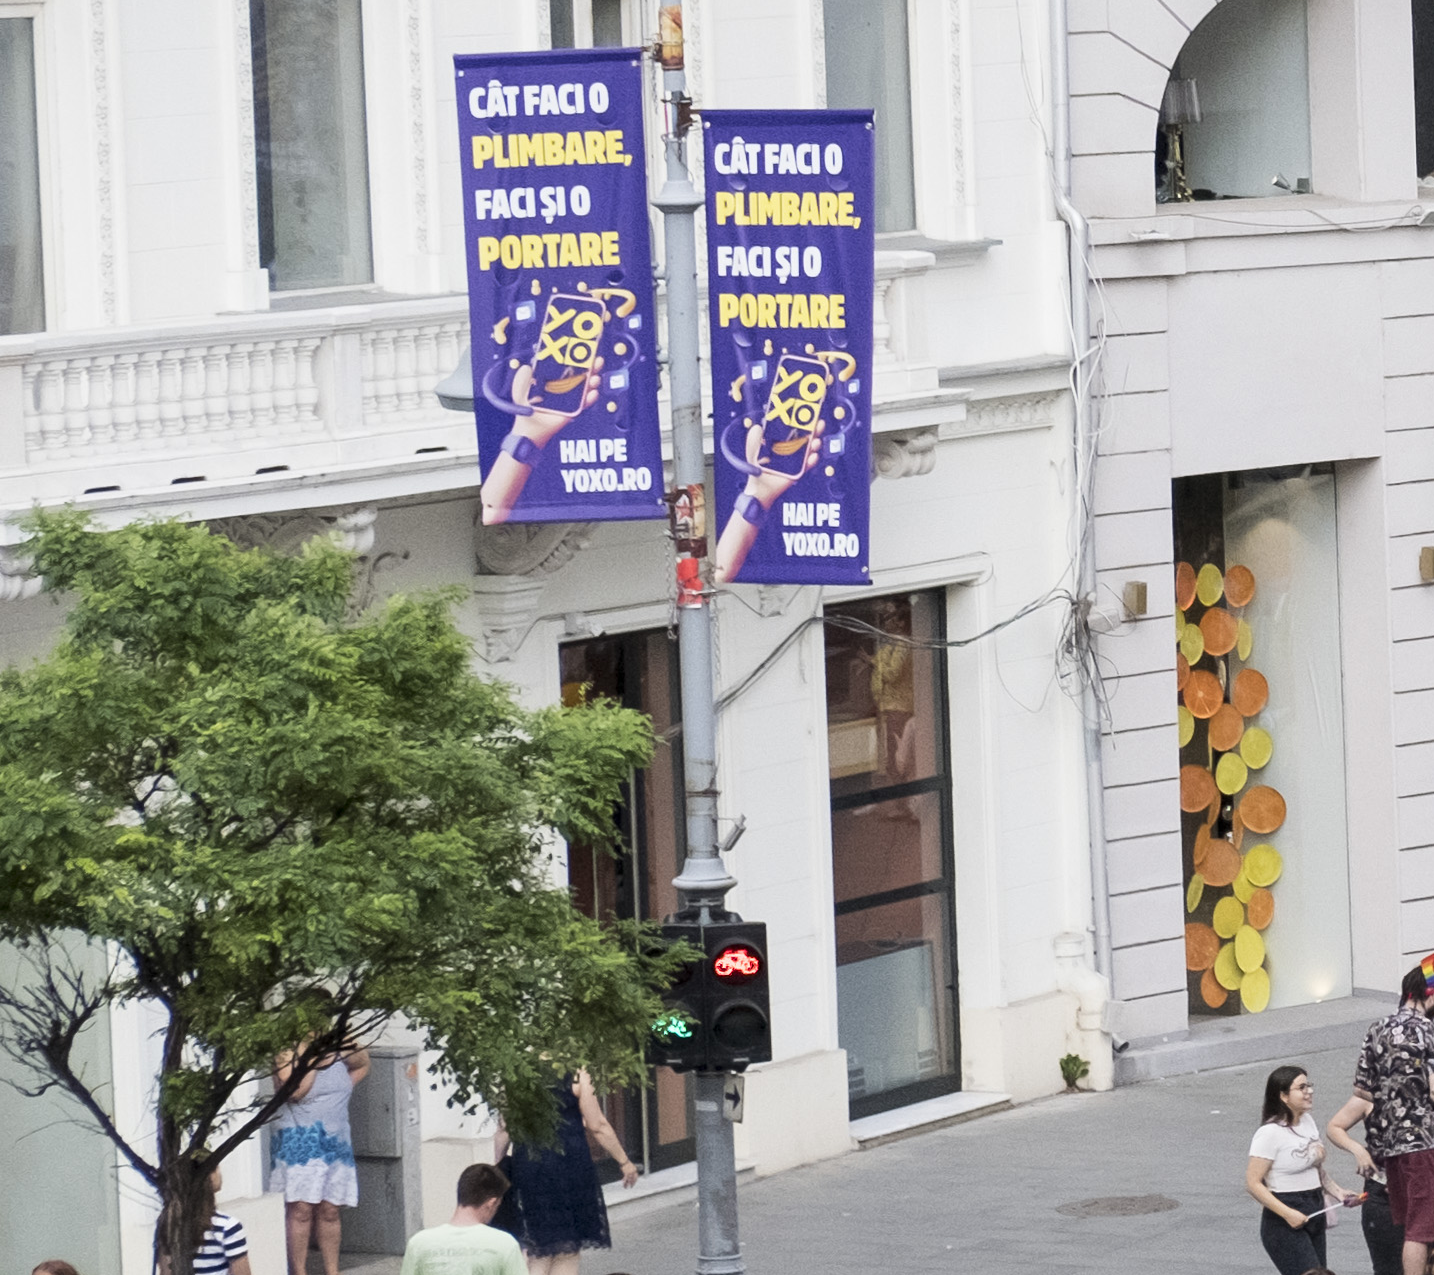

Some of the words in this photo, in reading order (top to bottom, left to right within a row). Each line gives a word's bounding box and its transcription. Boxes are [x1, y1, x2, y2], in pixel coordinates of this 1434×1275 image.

[469, 80, 519, 118] CÂT
[524, 83, 585, 115] FACI
[589, 83, 609, 113] O
[472, 130, 632, 169] PLIMBARE,
[714, 136, 761, 174] CÂT
[765, 143, 820, 174] FACI
[825, 144, 842, 174] O
[475, 188, 536, 220] FACI
[570, 186, 590, 215] O
[716, 192, 861, 229] PLIMBARE,
[478, 232, 620, 270] PORTARE
[718, 246, 771, 277] FACI
[805, 246, 821, 277] O
[719, 294, 845, 328] PORTARE
[560, 440, 597, 463] HAI
[600, 439, 627, 462] PE
[561, 467, 651, 492] YOXO.RO
[783, 503, 813, 526] HAI
[816, 503, 840, 527] PE
[783, 532, 859, 557] YOXO.RO
